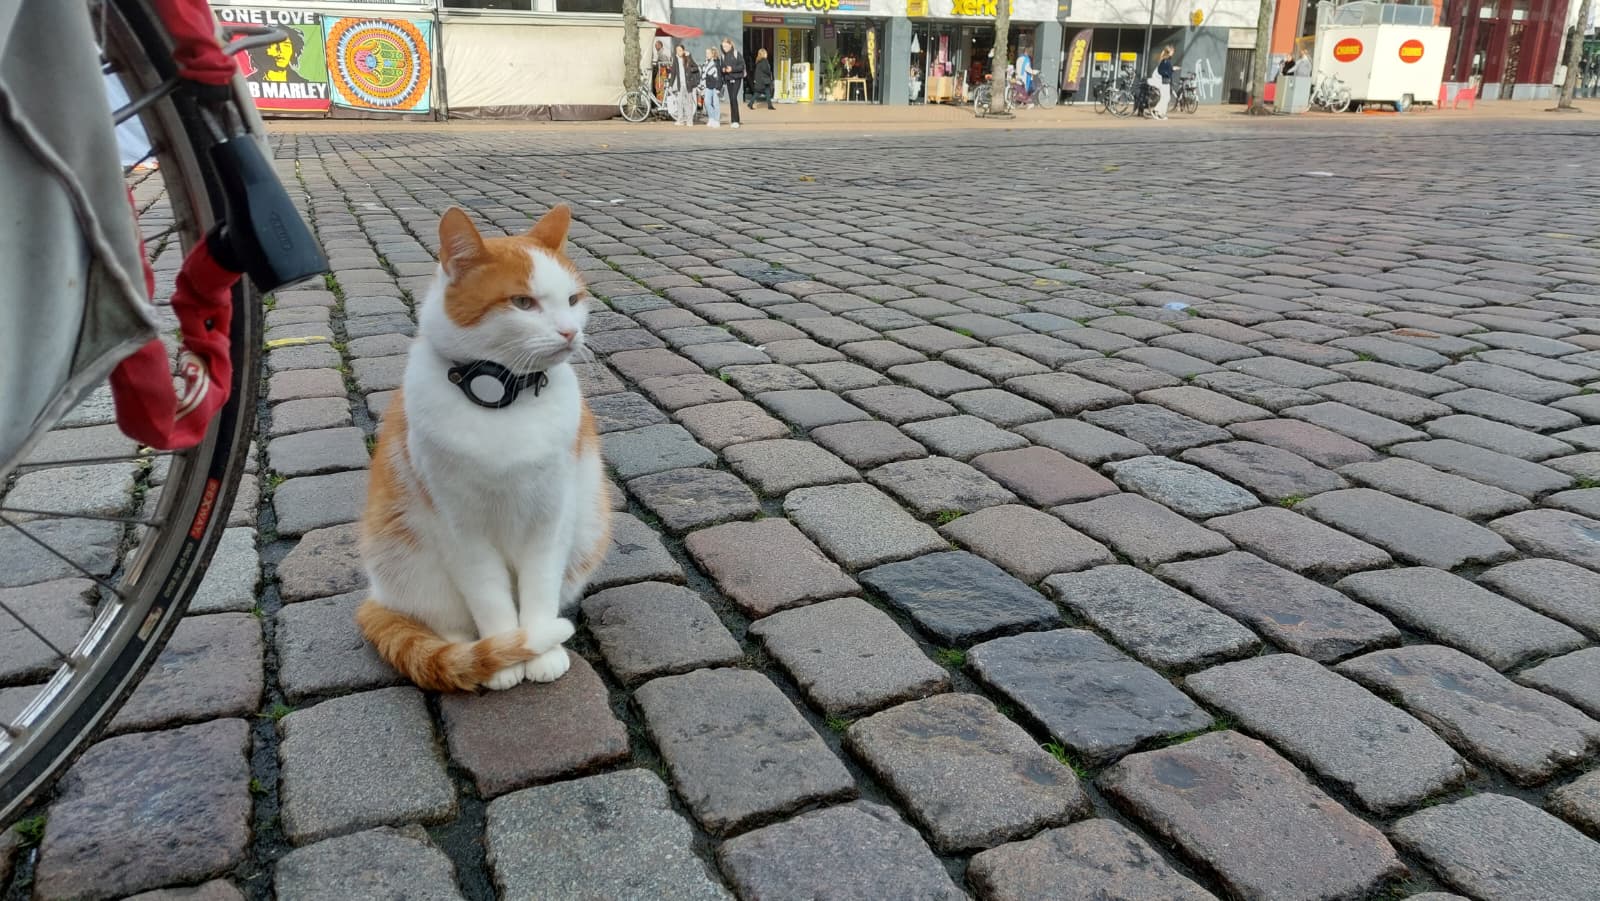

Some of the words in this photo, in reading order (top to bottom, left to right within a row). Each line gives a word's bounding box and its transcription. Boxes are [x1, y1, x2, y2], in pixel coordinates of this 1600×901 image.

[221, 8, 262, 24] ONE
[266, 10, 315, 25] LOVE
[261, 83, 326, 99] MARLEY
